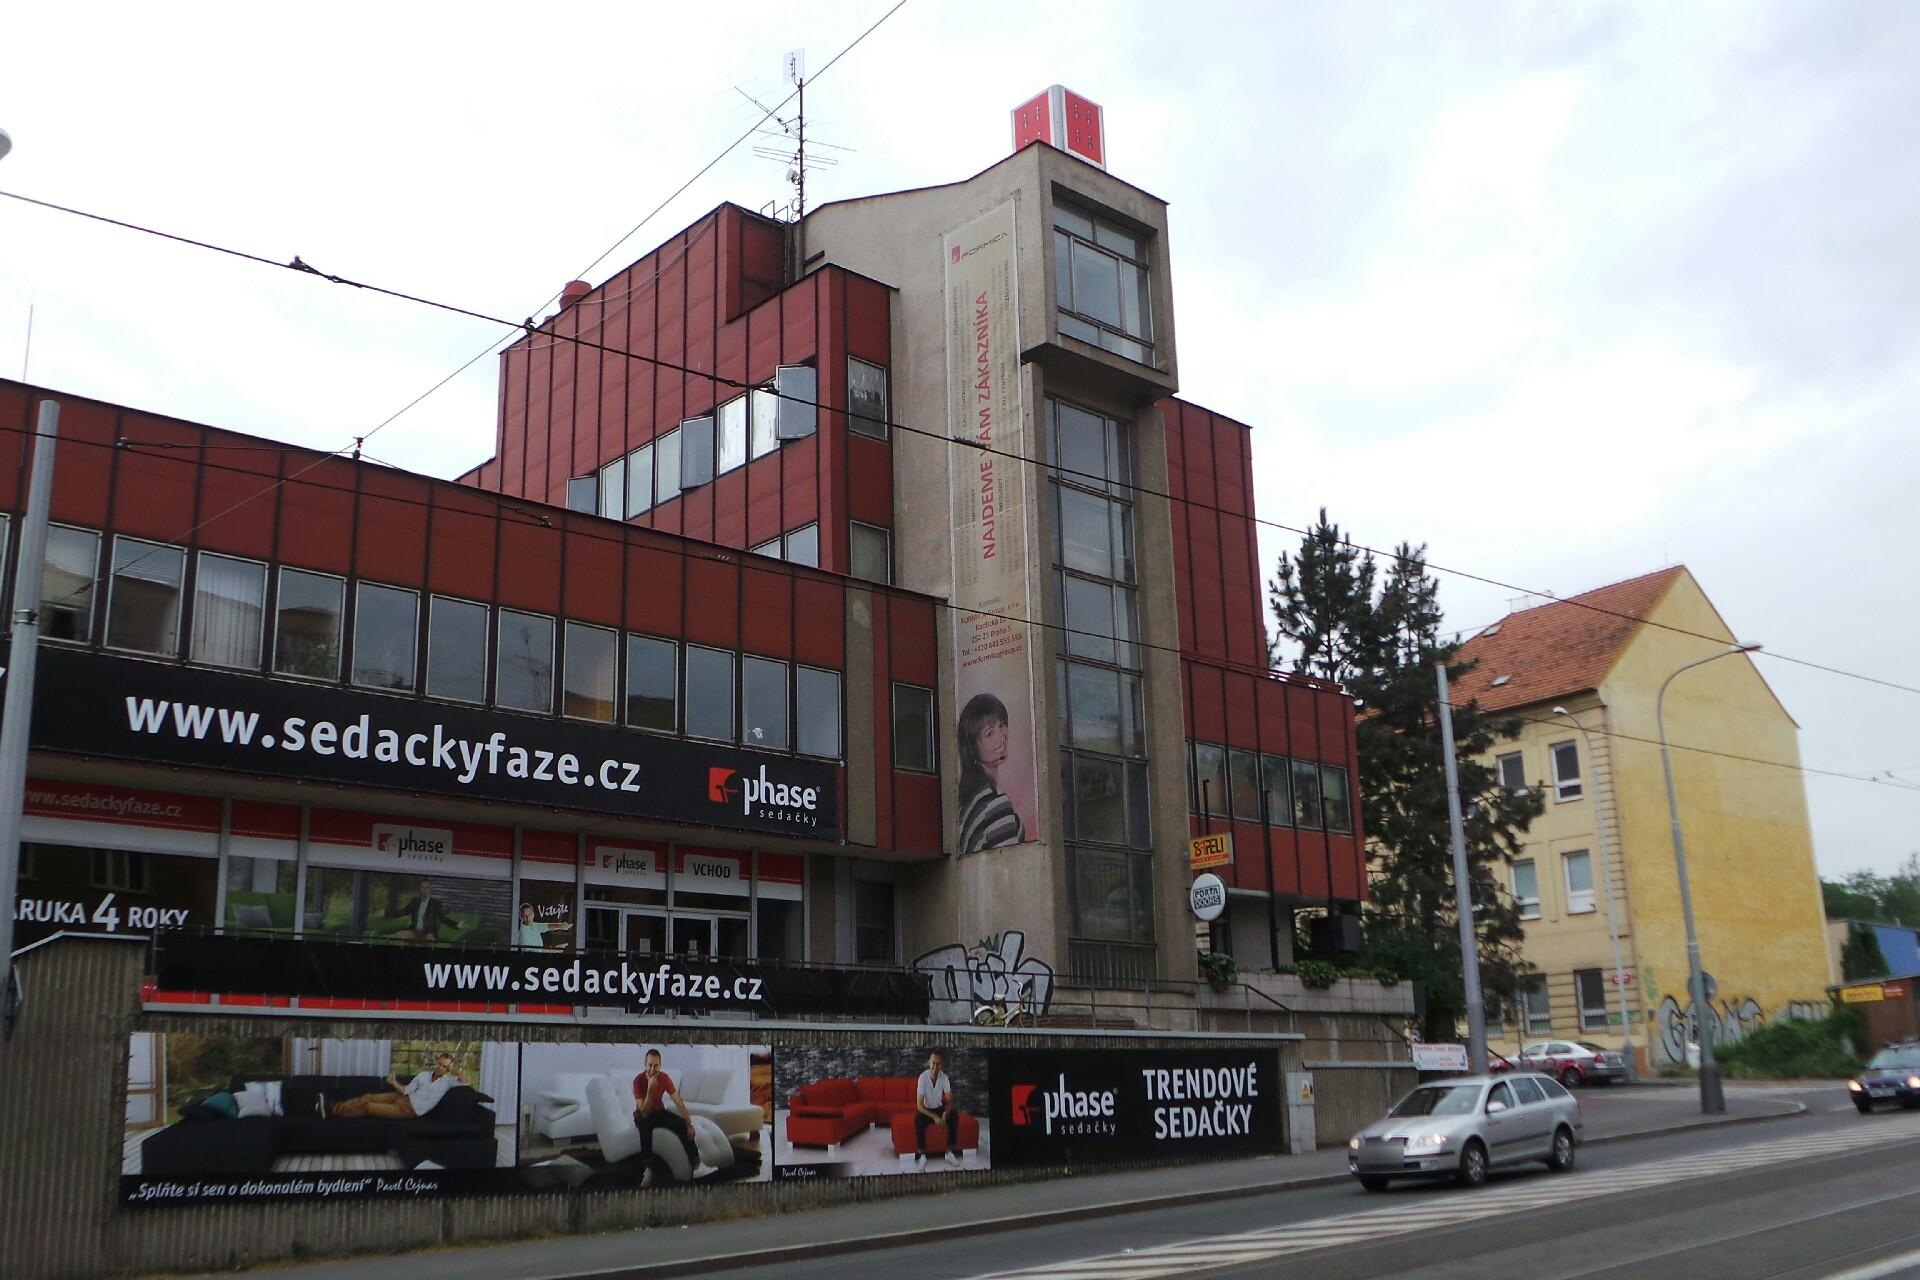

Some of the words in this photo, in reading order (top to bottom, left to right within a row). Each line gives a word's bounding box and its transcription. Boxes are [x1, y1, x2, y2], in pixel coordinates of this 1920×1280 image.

[974, 290, 991, 404] ZÁKAZNÍKA
[981, 459, 996, 560] NAJDEME
[126, 696, 642, 792] www.sedackyfaze.cz
[742, 764, 817, 816] phase
[398, 830, 444, 859] phase
[616, 853, 647, 873] phase
[693, 862, 731, 879] VCHOD
[92, 893, 120, 932] 4
[128, 906, 189, 930] ROKY
[424, 959, 763, 1004] www.sedackyfaze.cz
[1142, 1062, 1259, 1101] TRENDOVÉ
[1043, 1073, 1115, 1135] phase
[1154, 1100, 1253, 1140] SEDAČKY
[187, 1181, 201, 1198] si
[201, 1182, 225, 1197] sen
[228, 1183, 237, 1197] o
[239, 1178, 313, 1197] dokonalém
